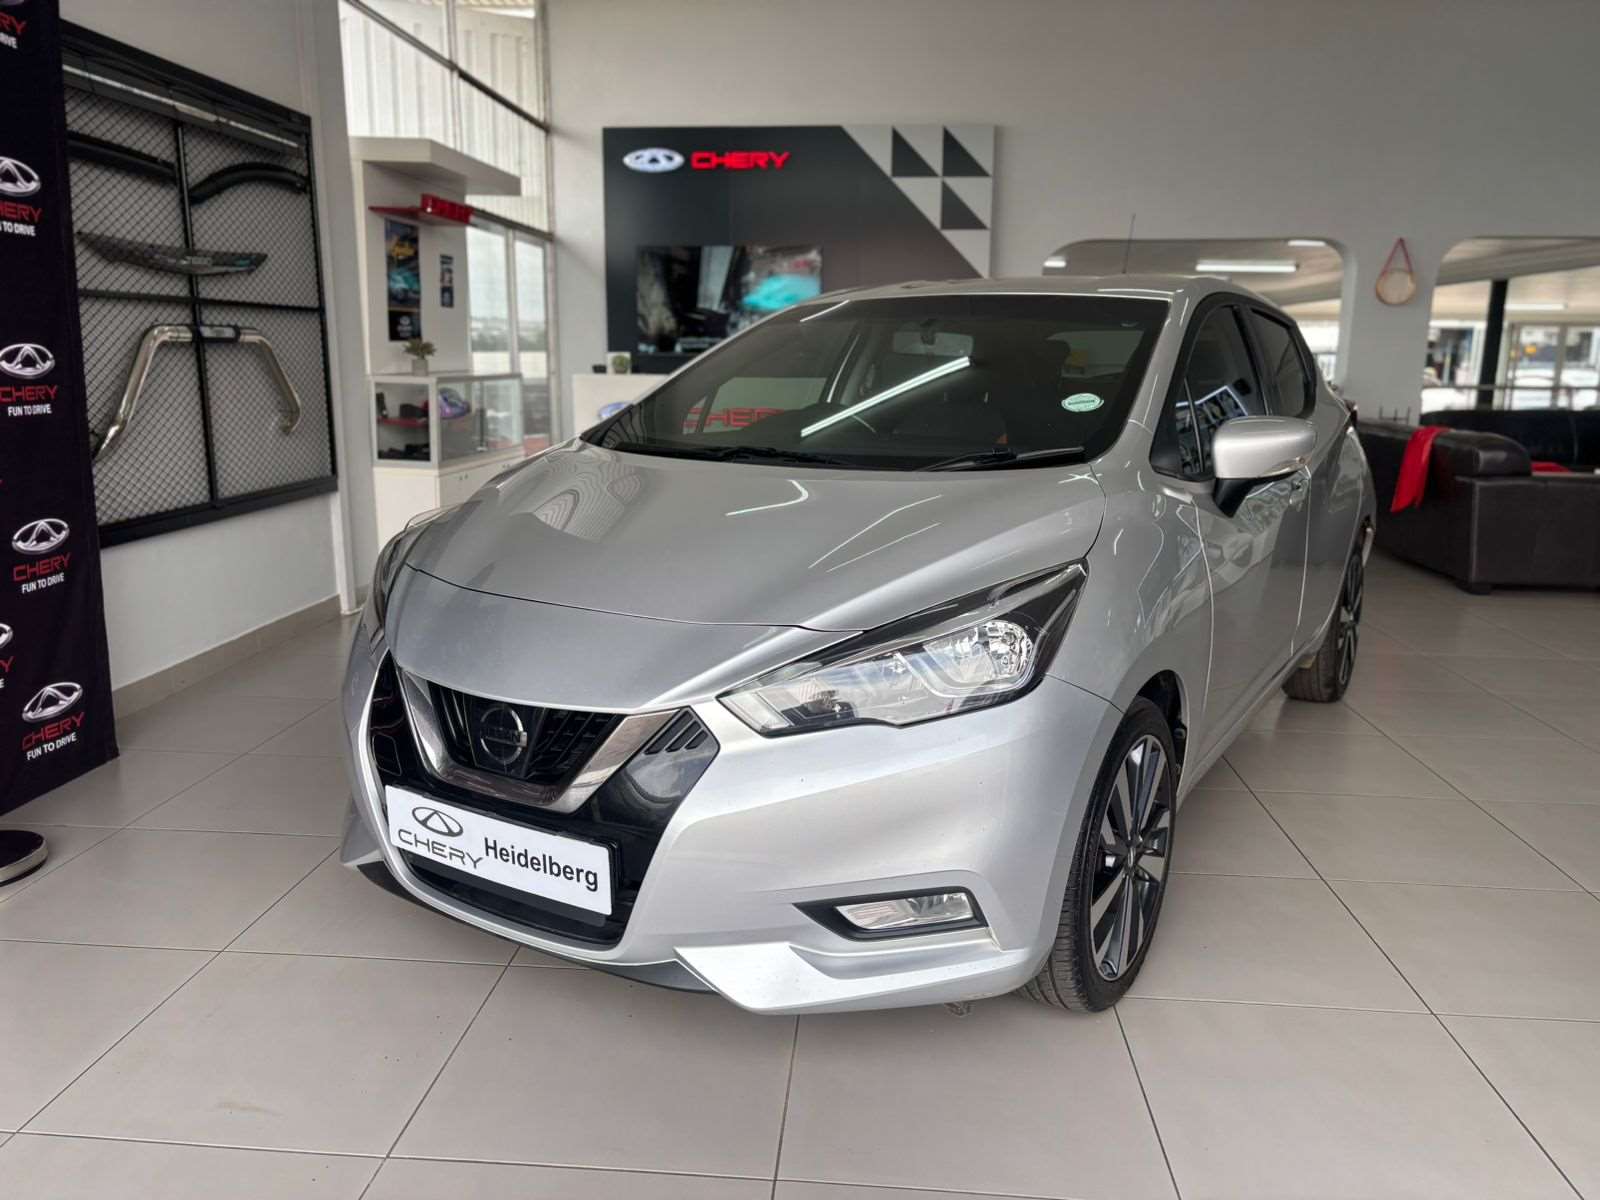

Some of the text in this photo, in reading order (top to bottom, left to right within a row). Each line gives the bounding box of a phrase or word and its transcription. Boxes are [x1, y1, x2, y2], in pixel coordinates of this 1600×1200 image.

[691, 152, 789, 169] CHERY
[14, 223, 36, 237] DRIVE
[0, 384, 58, 402] CHERY
[8, 404, 52, 417] FUN TO DRIVE
[13, 552, 71, 582] CHERY
[21, 572, 65, 594] FUN TO DRIVE
[22, 712, 85, 751] CHERY
[26, 732, 77, 761] FUN TO DRIVE
[398, 828, 483, 869] CHERY
[484, 837, 598, 892] Heidelberg
